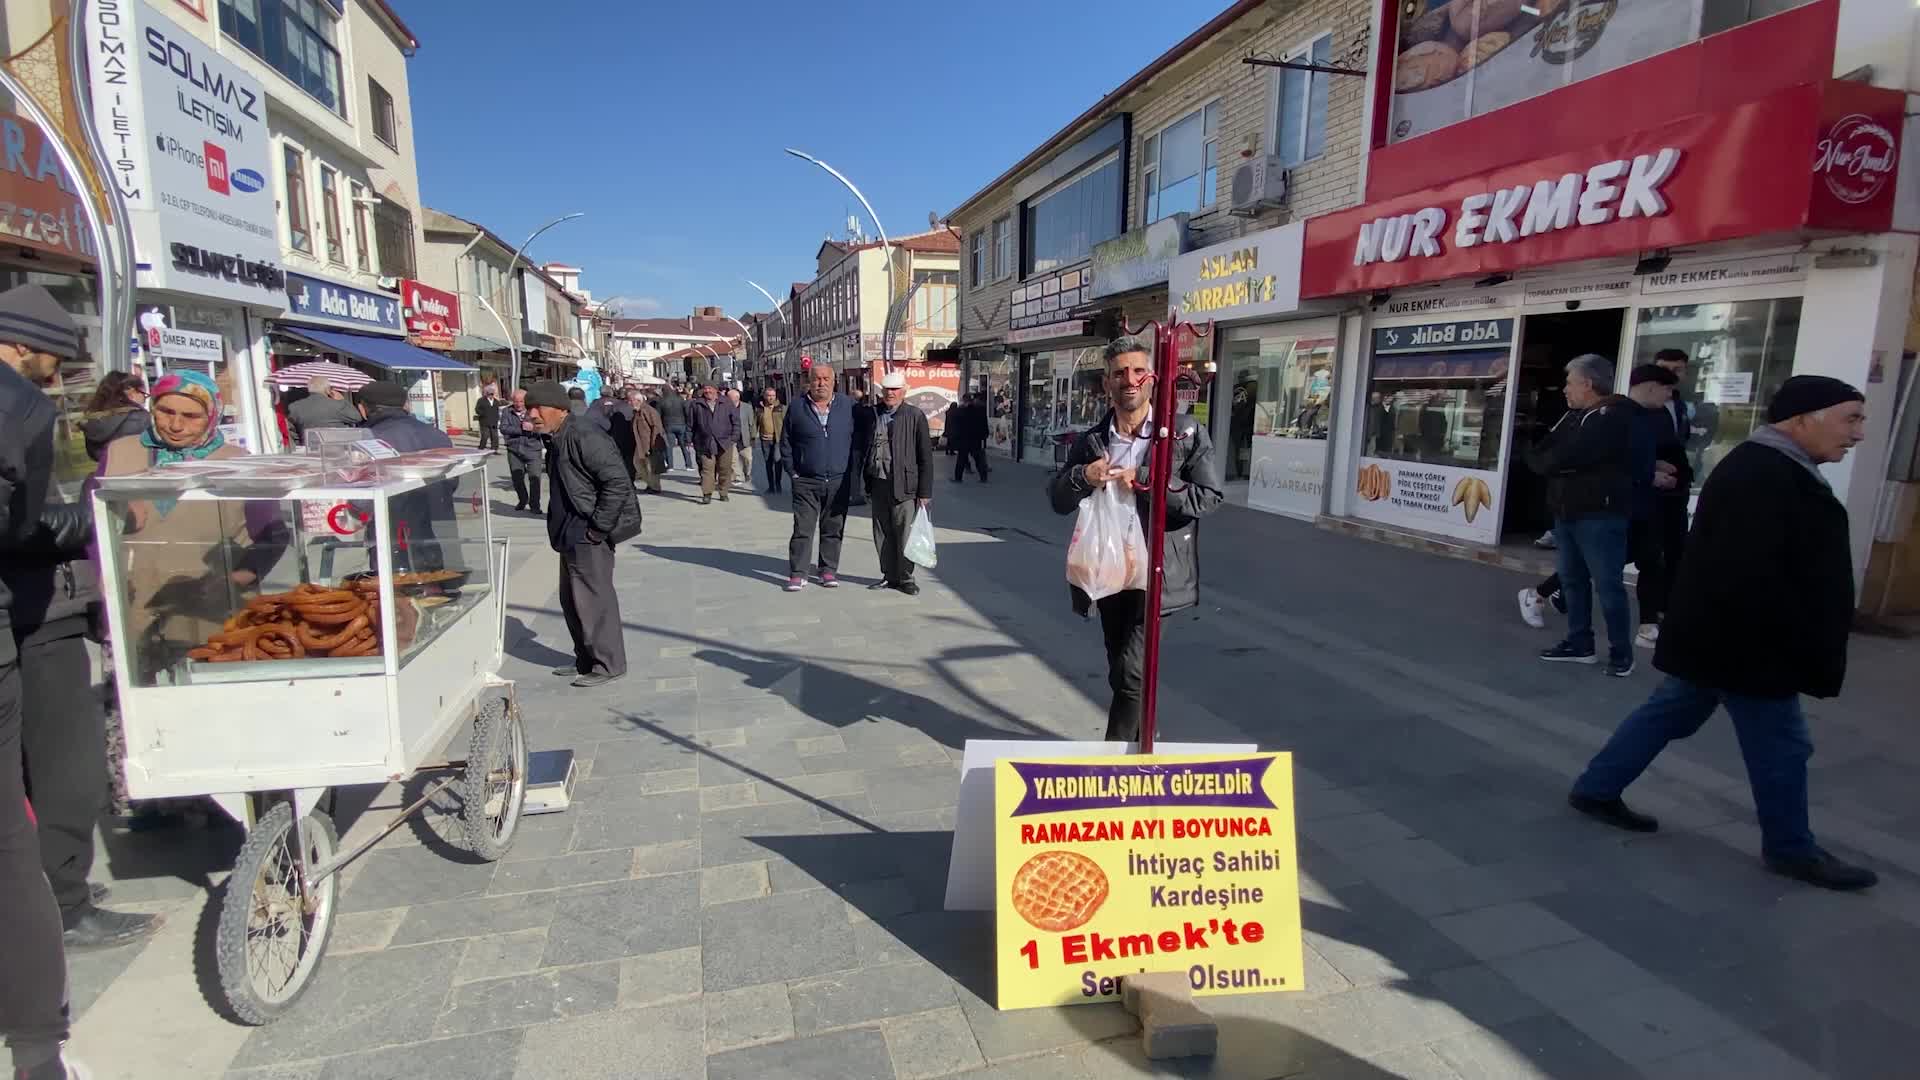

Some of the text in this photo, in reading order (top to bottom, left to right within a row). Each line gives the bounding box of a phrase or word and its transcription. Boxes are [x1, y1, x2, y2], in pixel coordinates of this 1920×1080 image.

[145, 26, 259, 122] SOLMAZ
[177, 85, 243, 143] İLETİŞİM
[166, 137, 205, 168] iPhone
[1353, 148, 1681, 266] NUR EKMEK
[1200, 246, 1258, 280] ASLAN
[1650, 275, 1677, 287] NUR
[1681, 269, 1729, 284] EKMEK
[321, 287, 348, 317] Ada
[1388, 302, 1409, 313] NUR
[1412, 298, 1446, 311] EKMEK
[162, 331, 220, 350] ÖMER AÇIKEL
[1400, 489, 1415, 499] TAVA
[1034, 768, 1253, 802] YARDIMLAŞMAK GÜZELDİR
[1021, 817, 1272, 844] RAMAZAN AYI BOYUNCA
[1128, 849, 1281, 879] İhtiyaç Sahibi
[1150, 883, 1264, 910] Kardeşine
[1020, 918, 1265, 969] 1 Ekmek'te
[1189, 964, 1286, 990] Olsun...
